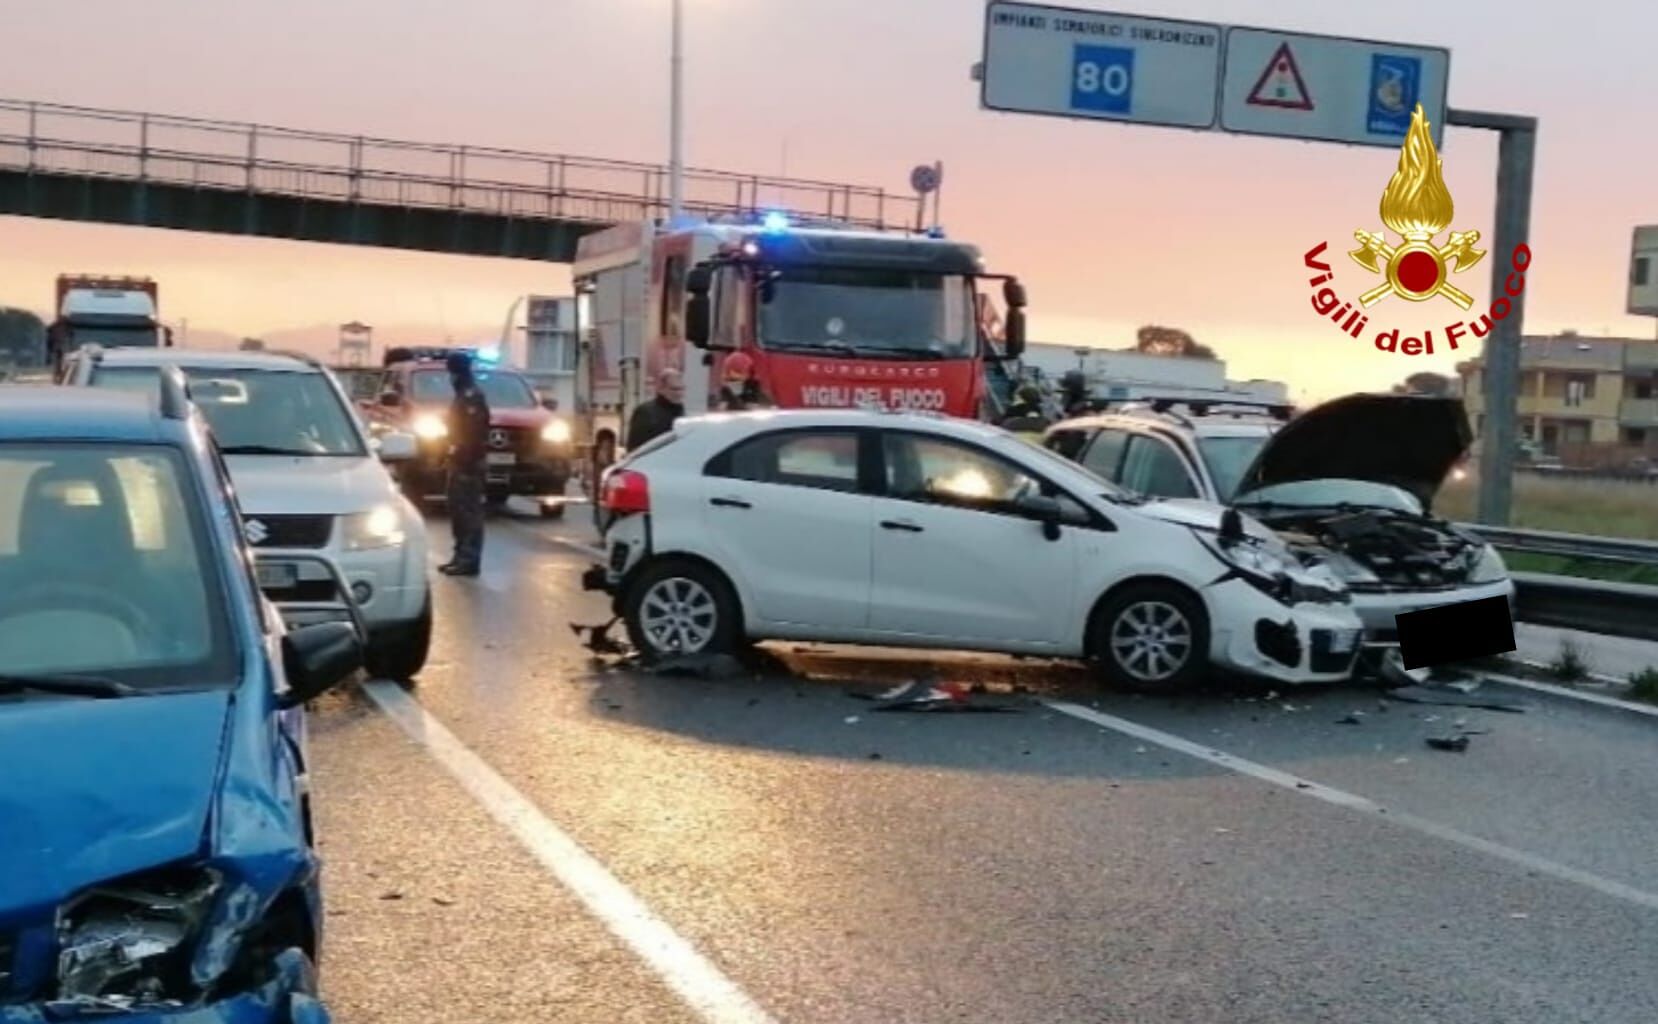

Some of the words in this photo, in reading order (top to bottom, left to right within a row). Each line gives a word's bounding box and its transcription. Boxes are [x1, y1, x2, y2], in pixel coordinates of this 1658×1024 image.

[1078, 61, 1128, 96] 80
[801, 385, 849, 406] VIGILI
[854, 386, 887, 407] DEL
[890, 387, 945, 409] FUOCO
